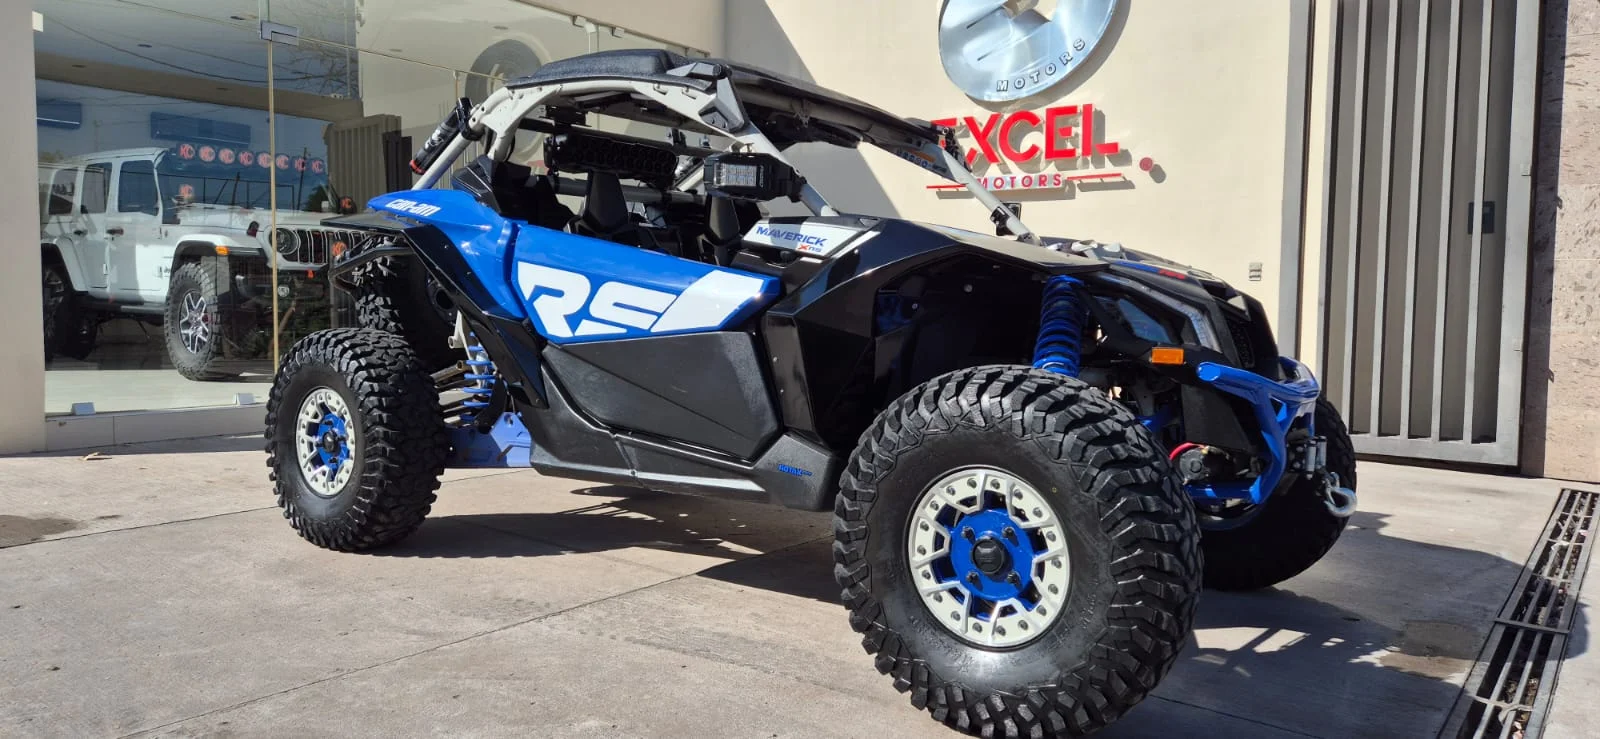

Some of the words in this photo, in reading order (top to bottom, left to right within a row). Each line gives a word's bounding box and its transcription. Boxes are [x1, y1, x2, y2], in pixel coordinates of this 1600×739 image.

[996, 38, 1086, 92] MOTORS
[756, 226, 828, 247] MAVERICK
[517, 261, 679, 338] RS
